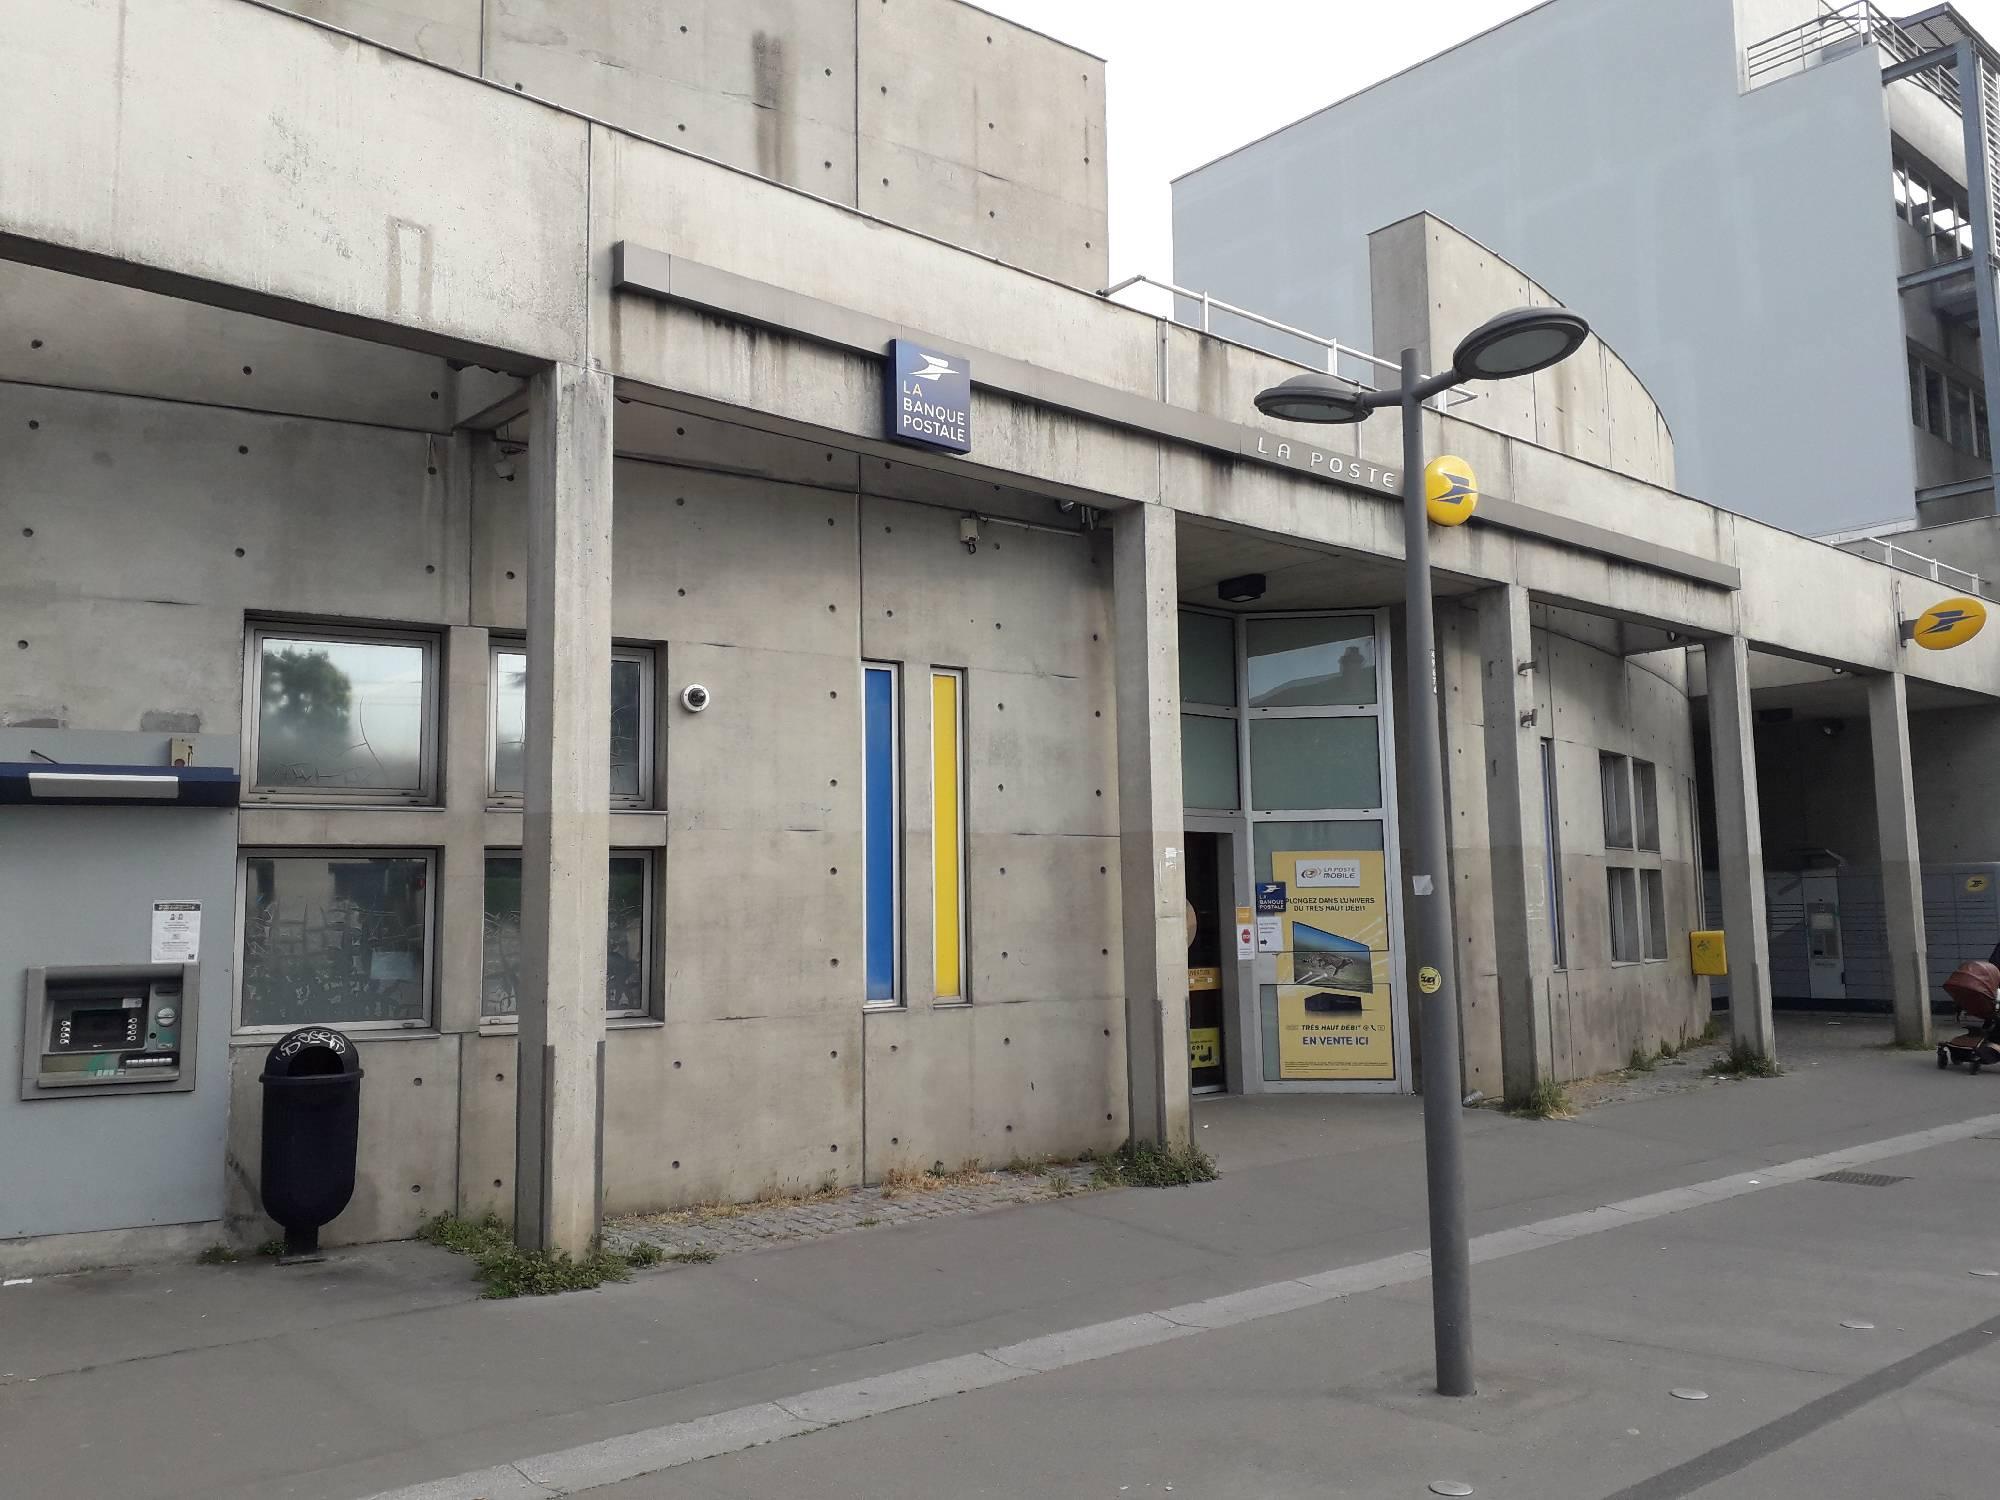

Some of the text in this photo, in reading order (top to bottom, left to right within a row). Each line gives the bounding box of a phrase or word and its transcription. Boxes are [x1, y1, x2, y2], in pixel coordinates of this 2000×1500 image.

[903, 380, 922, 397] LA
[903, 397, 965, 426] BANQUE
[903, 414, 965, 442] POSTALE
[1257, 436, 1396, 488] LA POSTE
[1293, 904, 1303, 912] DU
[1325, 904, 1343, 912] HAUT
[1302, 1036, 1369, 1046] EN VENTE ICI
